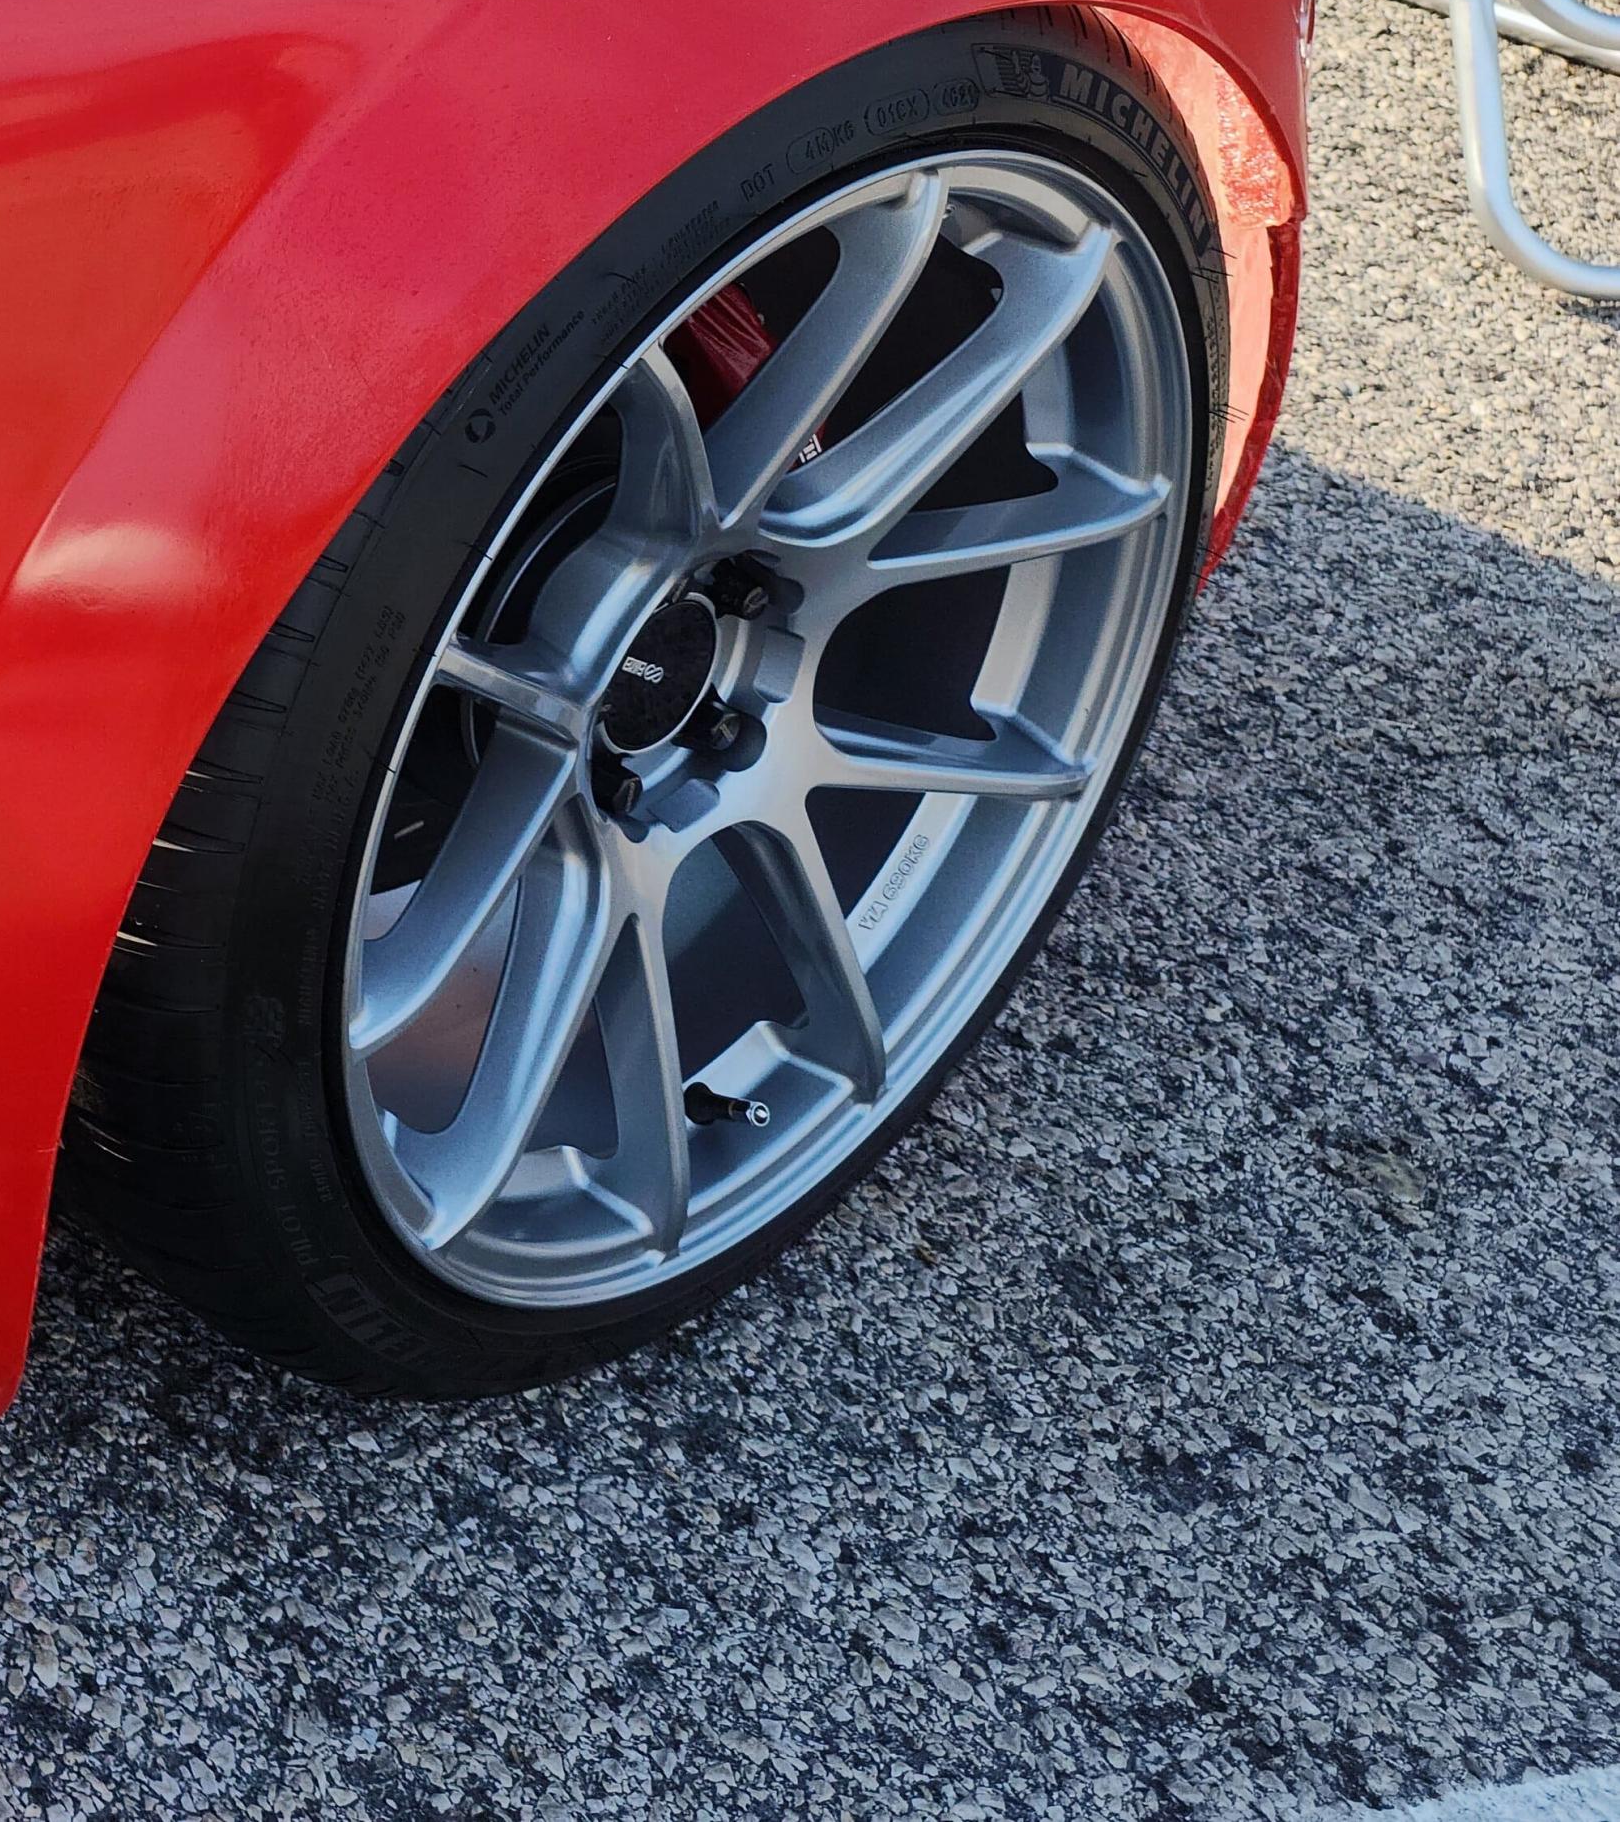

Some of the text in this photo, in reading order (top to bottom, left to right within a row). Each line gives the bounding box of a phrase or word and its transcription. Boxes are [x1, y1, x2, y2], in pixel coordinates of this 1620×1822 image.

[740, 163, 776, 203] DOT
[1059, 62, 1210, 241] MICHELIN
[488, 323, 551, 405] MICHELIN
[497, 310, 586, 416] Total Performance
[275, 1201, 320, 1277] PILOT
